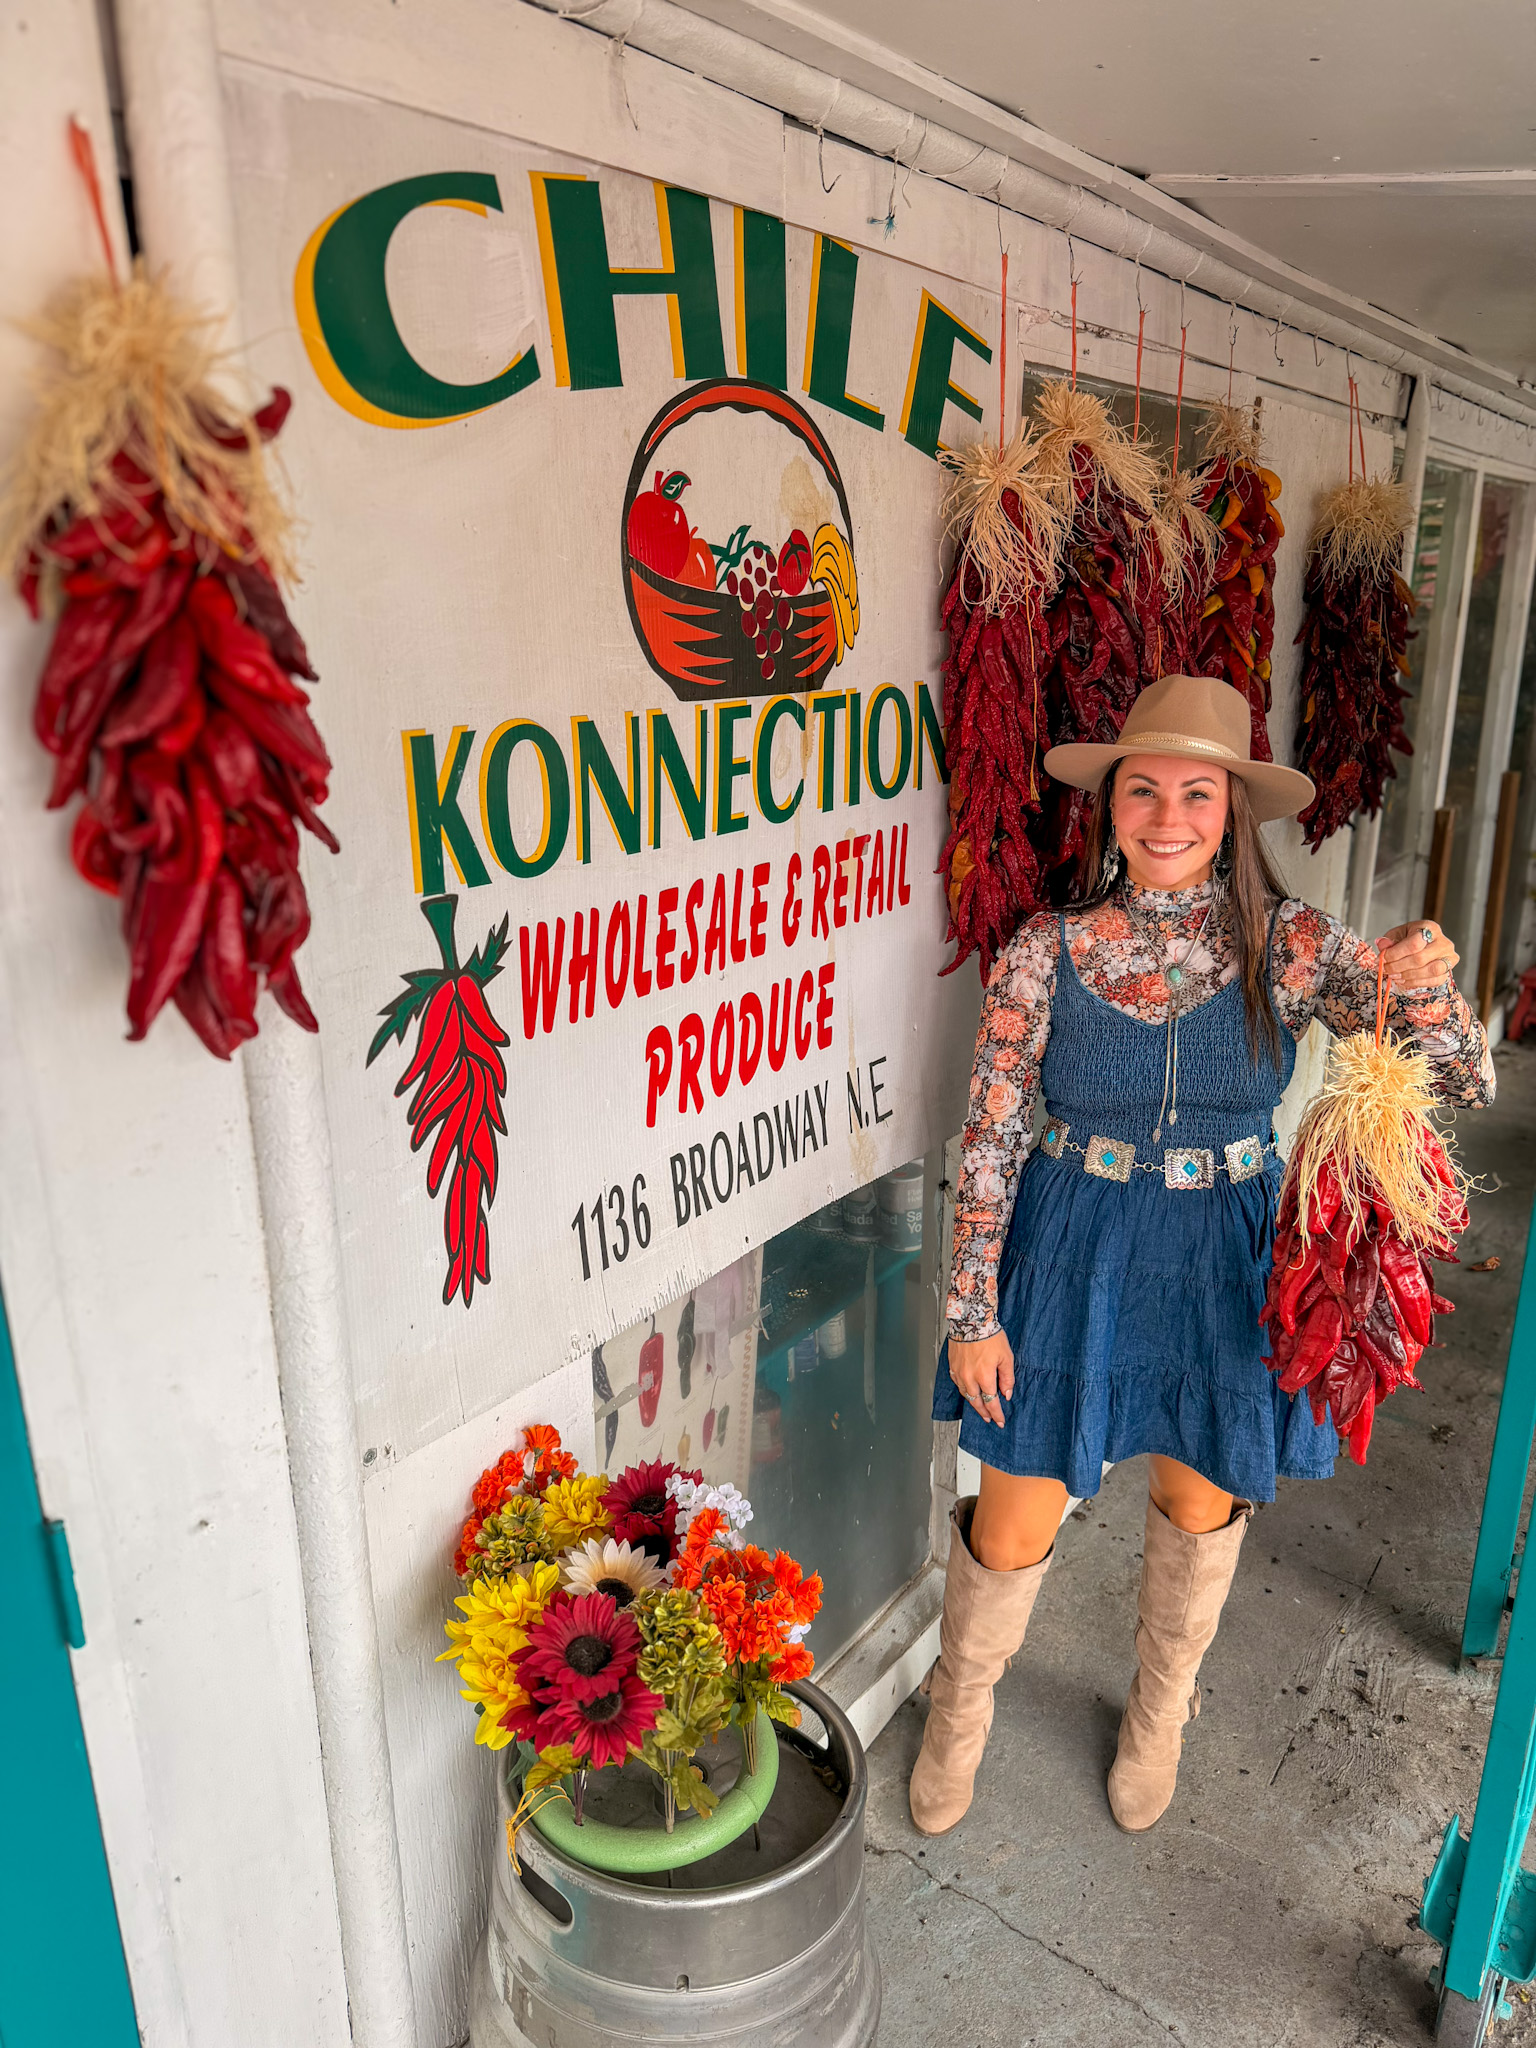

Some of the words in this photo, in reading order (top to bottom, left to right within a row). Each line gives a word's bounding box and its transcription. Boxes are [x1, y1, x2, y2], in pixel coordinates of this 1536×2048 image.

[293, 170, 993, 478] CHILE
[401, 681, 951, 898] KONNECTION
[519, 862, 770, 1039] WHOLESALE
[782, 852, 802, 947] &
[811, 823, 911, 941] RETAIL
[645, 961, 836, 1128] PRODUCE
[571, 1173, 651, 1281] 1136
[669, 1080, 829, 1228] BROADWAY
[846, 1056, 893, 1134] N.E
